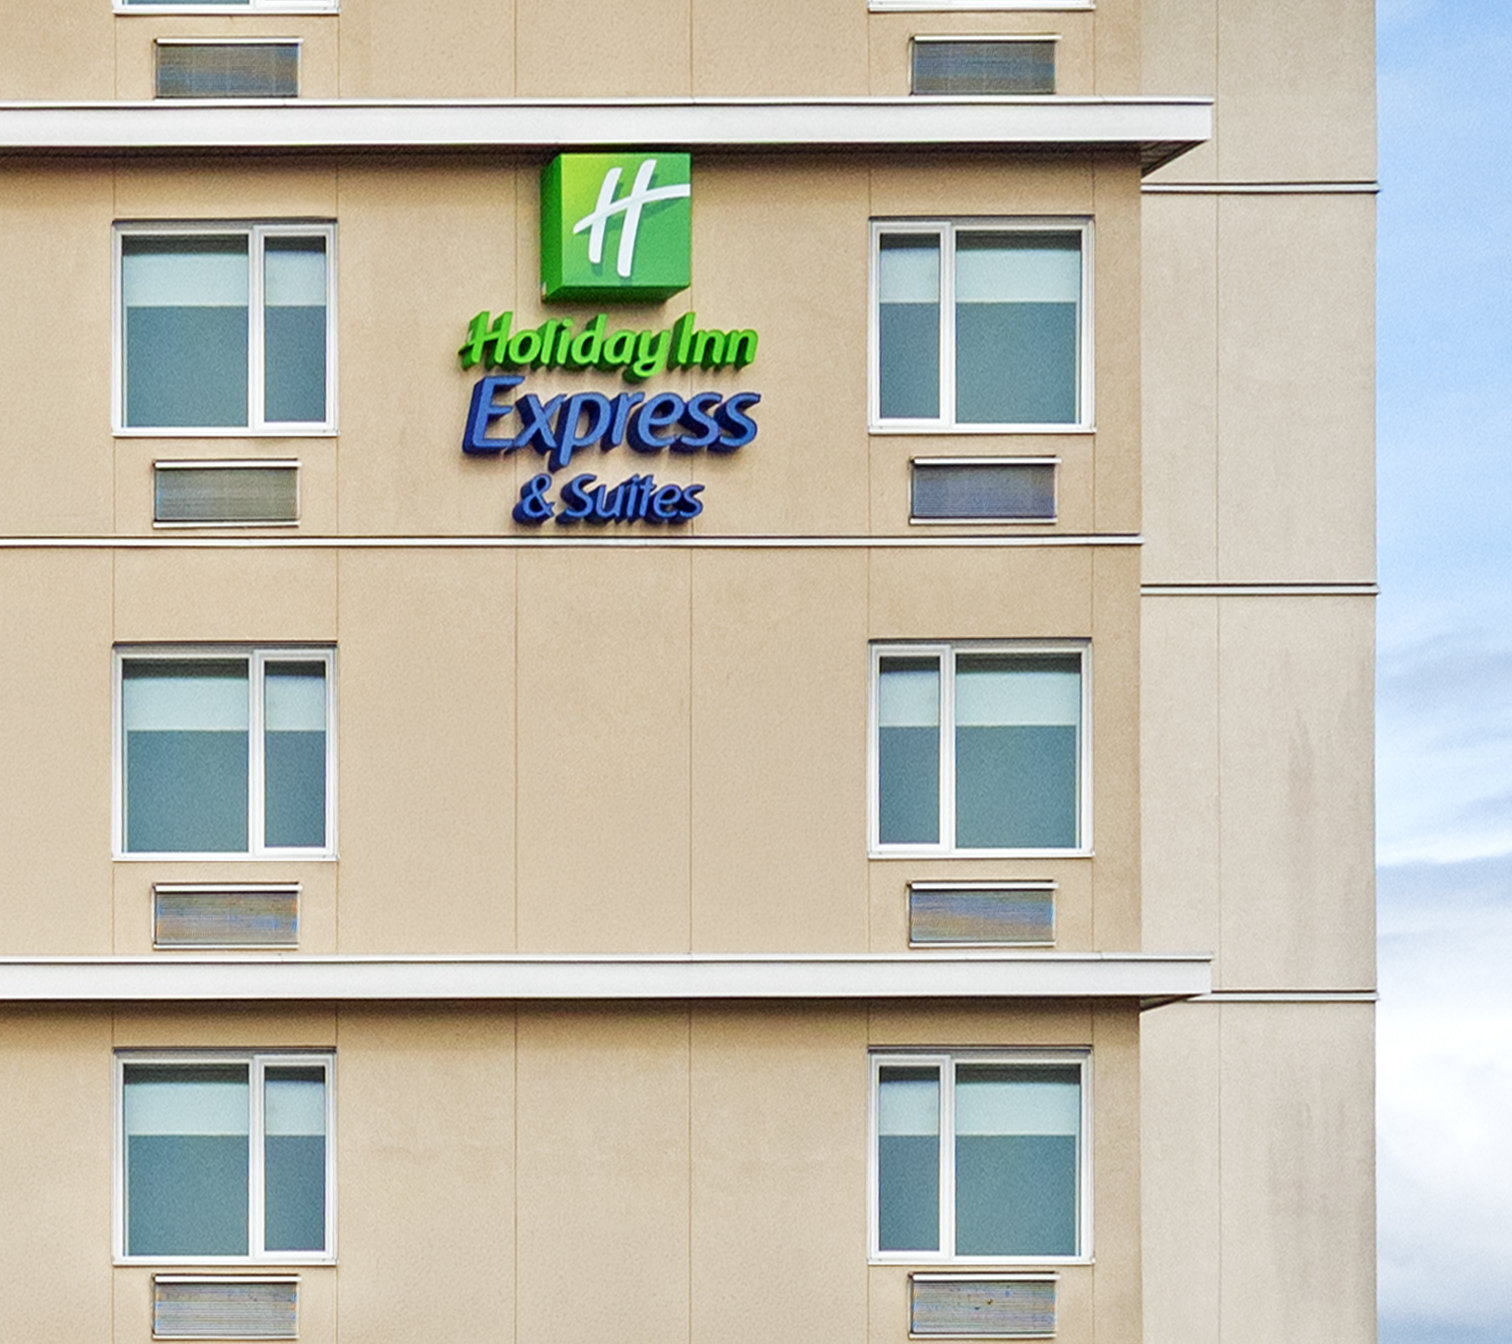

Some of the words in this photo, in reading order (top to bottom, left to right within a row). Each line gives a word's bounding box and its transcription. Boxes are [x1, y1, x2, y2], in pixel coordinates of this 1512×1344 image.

[458, 311, 670, 383] Holiday
[669, 312, 759, 370] Inn
[463, 375, 762, 471] Express
[514, 472, 556, 524] &
[558, 472, 706, 524] Suites
